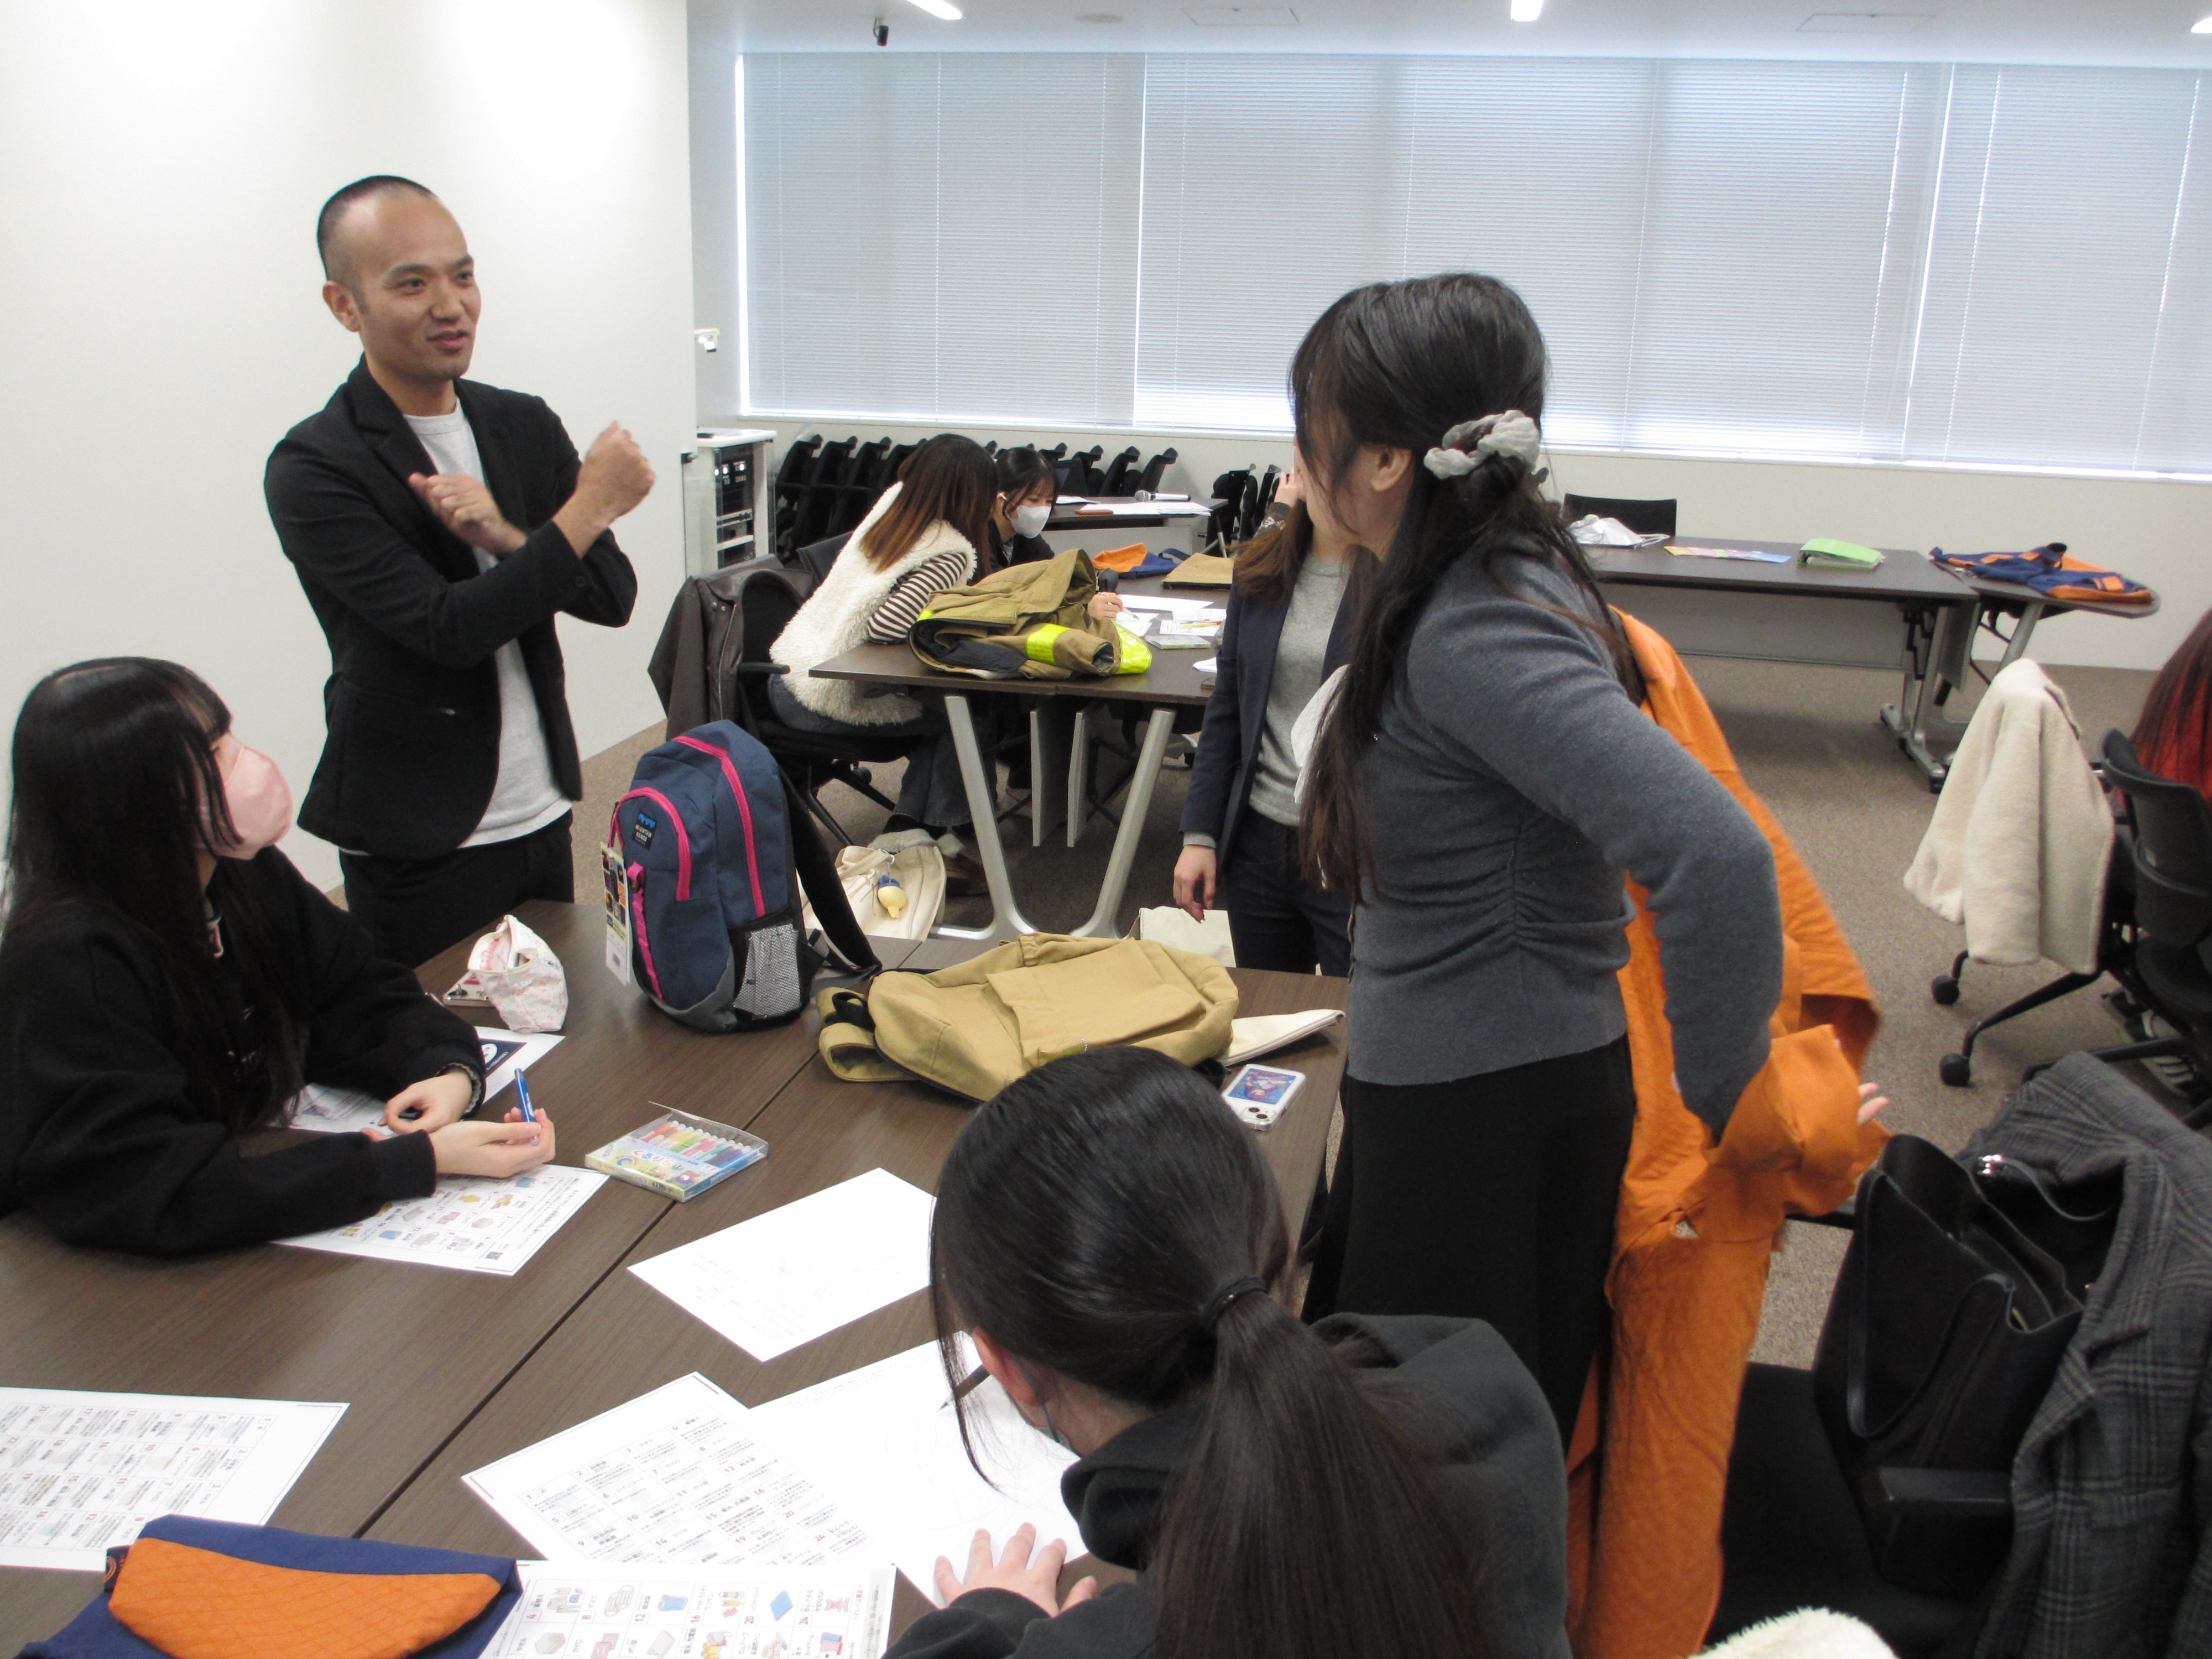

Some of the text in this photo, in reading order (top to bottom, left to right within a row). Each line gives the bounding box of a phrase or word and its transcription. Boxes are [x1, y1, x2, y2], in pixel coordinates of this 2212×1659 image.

[782, 1510, 795, 1519] 20
[587, 1595, 598, 1609] マスク
[703, 1593, 715, 1610] ランタン
[748, 1587, 761, 1611] レジャーシート
[635, 1614, 645, 1622] 12
[690, 1615, 701, 1623] 16
[744, 1615, 754, 1624] 20
[799, 1616, 808, 1625] 24
[737, 1631, 750, 1655] ガムテープ
